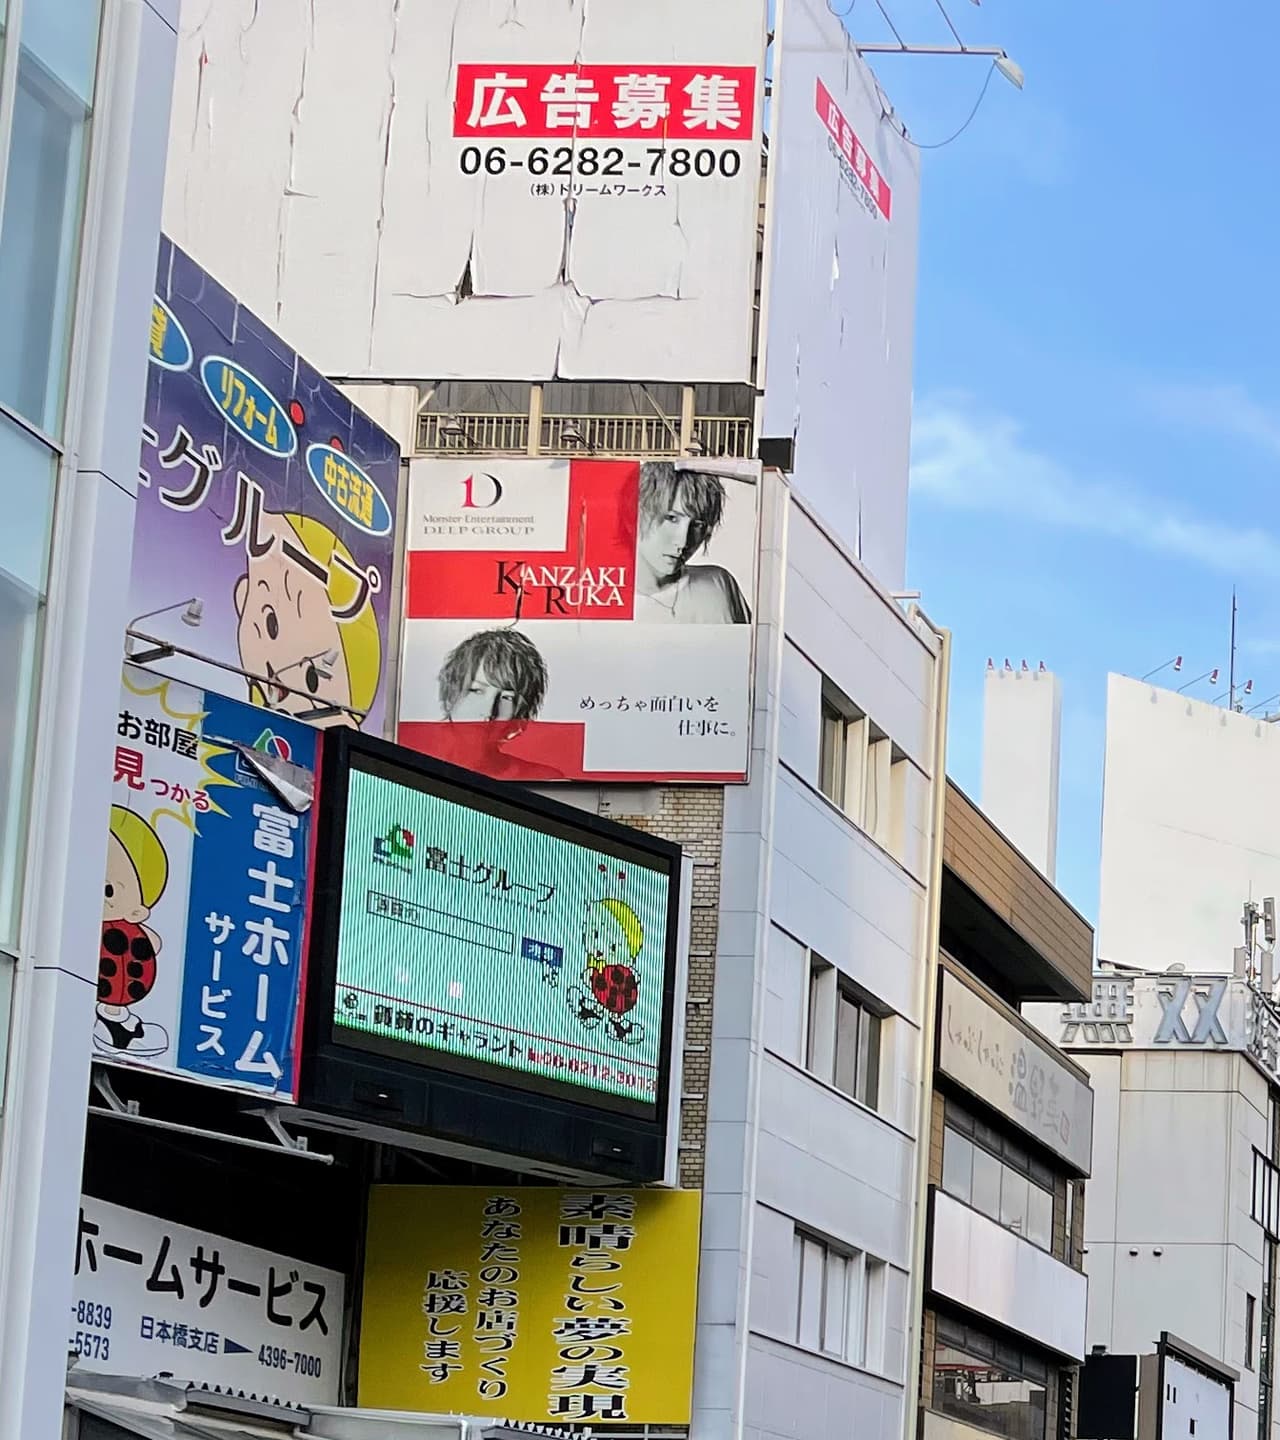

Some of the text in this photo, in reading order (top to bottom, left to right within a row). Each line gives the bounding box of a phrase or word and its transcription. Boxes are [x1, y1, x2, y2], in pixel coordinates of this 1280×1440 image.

[465, 72, 742, 131] 広告募集
[459, 146, 742, 178] 06-6282-7800
[529, 182, 667, 197] (株)ドリームワークス
[219, 366, 279, 449] リフォーム
[323, 455, 375, 529] 中古流通
[423, 513, 536, 524] Monster Entertainment
[140, 424, 382, 622] グループ
[471, 525, 535, 535] GROUP
[496, 561, 627, 596] KANZAKI
[544, 585, 625, 615] RUKA
[579, 695, 719, 713] めっちゃ面白いを
[678, 718, 737, 737] 仕事に。
[117, 709, 199, 761] お部屋
[113, 746, 212, 812] 見つかる
[234, 802, 299, 1079] 富士ホーム
[196, 911, 235, 1056] サービス
[420, 1269, 470, 1385] 応援します
[474, 1196, 522, 1400] あなたのお店づくり
[547, 1192, 637, 1421] 素晴らしい夢の実現
[140, 1315, 322, 1378] 日本橋支店 4396-7000
